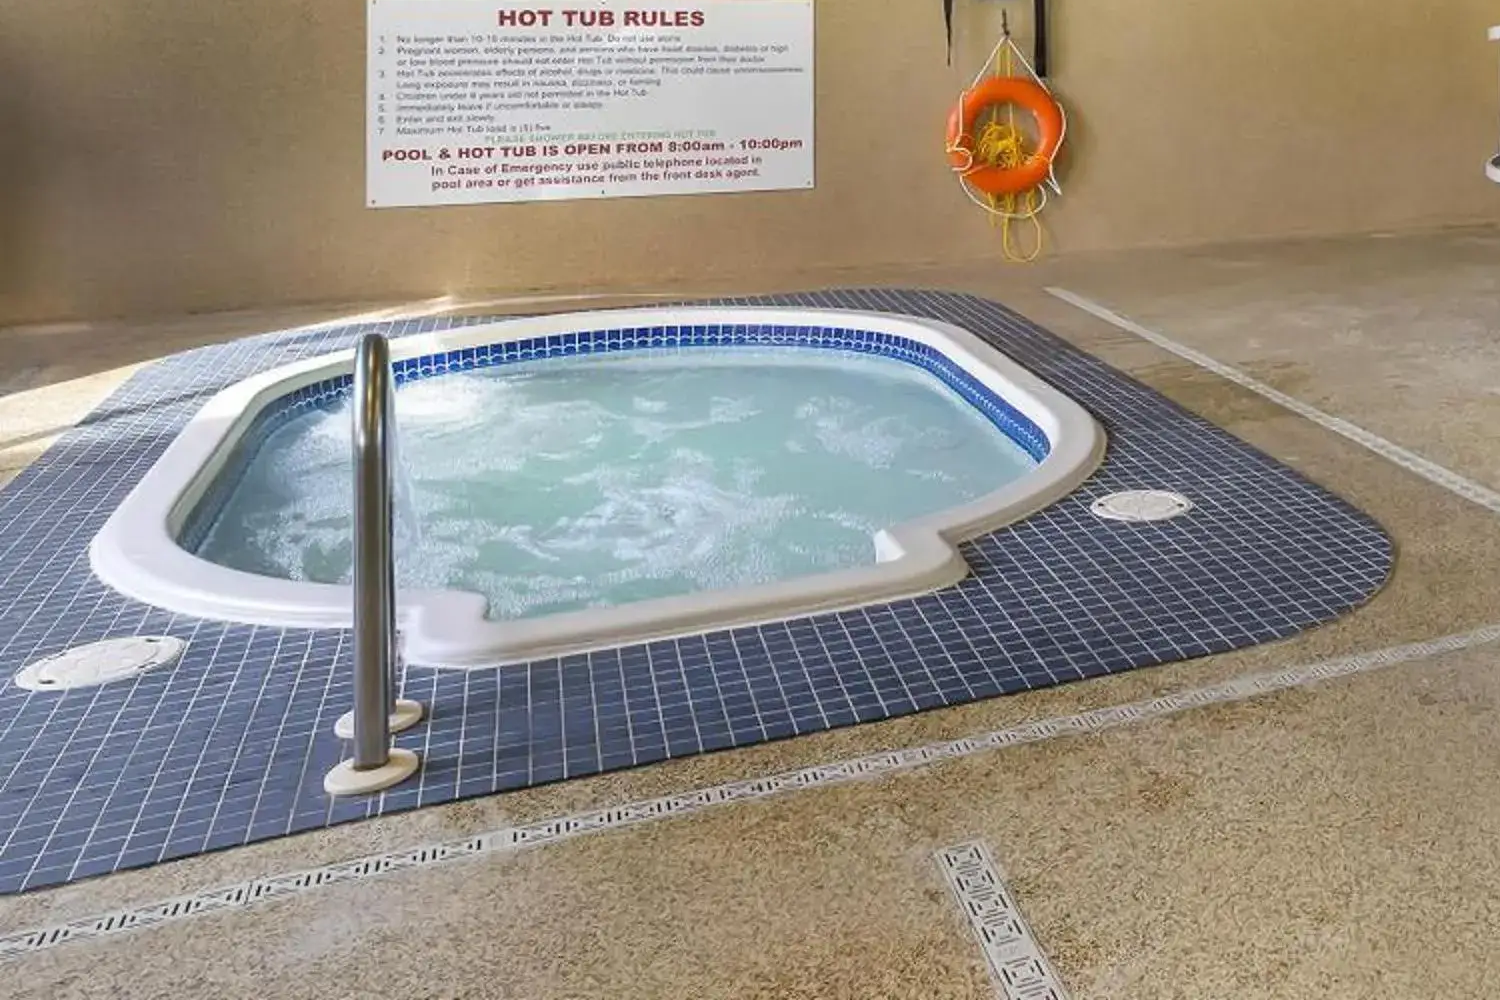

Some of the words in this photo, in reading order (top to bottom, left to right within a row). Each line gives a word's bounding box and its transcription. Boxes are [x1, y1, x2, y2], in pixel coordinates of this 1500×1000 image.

[498, 9, 553, 27] HOT
[562, 10, 615, 27] TUB
[623, 10, 705, 27] RULES
[382, 149, 432, 161] POOL
[439, 148, 451, 161] &
[458, 147, 495, 159] HOT
[500, 145, 537, 158] TUB
[542, 145, 559, 157] IS
[564, 143, 611, 155] OPEN
[616, 141, 663, 154] FROM
[667, 140, 726, 153] 8:00am
[739, 138, 803, 150] 10:00pm
[431, 165, 444, 177] In
[447, 164, 481, 175] Case
[485, 163, 499, 175] of
[501, 162, 574, 175] Emergency
[577, 162, 600, 171] use
[603, 158, 642, 171] public
[643, 156, 703, 170] telephone
[705, 155, 750, 166] located
[752, 156, 763, 165] in
[431, 179, 462, 192] pool
[464, 178, 494, 190] area
[496, 178, 512, 188] or
[514, 176, 537, 189] get
[538, 174, 606, 186] assistance
[608, 172, 638, 183] from
[641, 171, 661, 182] the
[663, 169, 692, 181] front
[695, 168, 724, 179] desk
